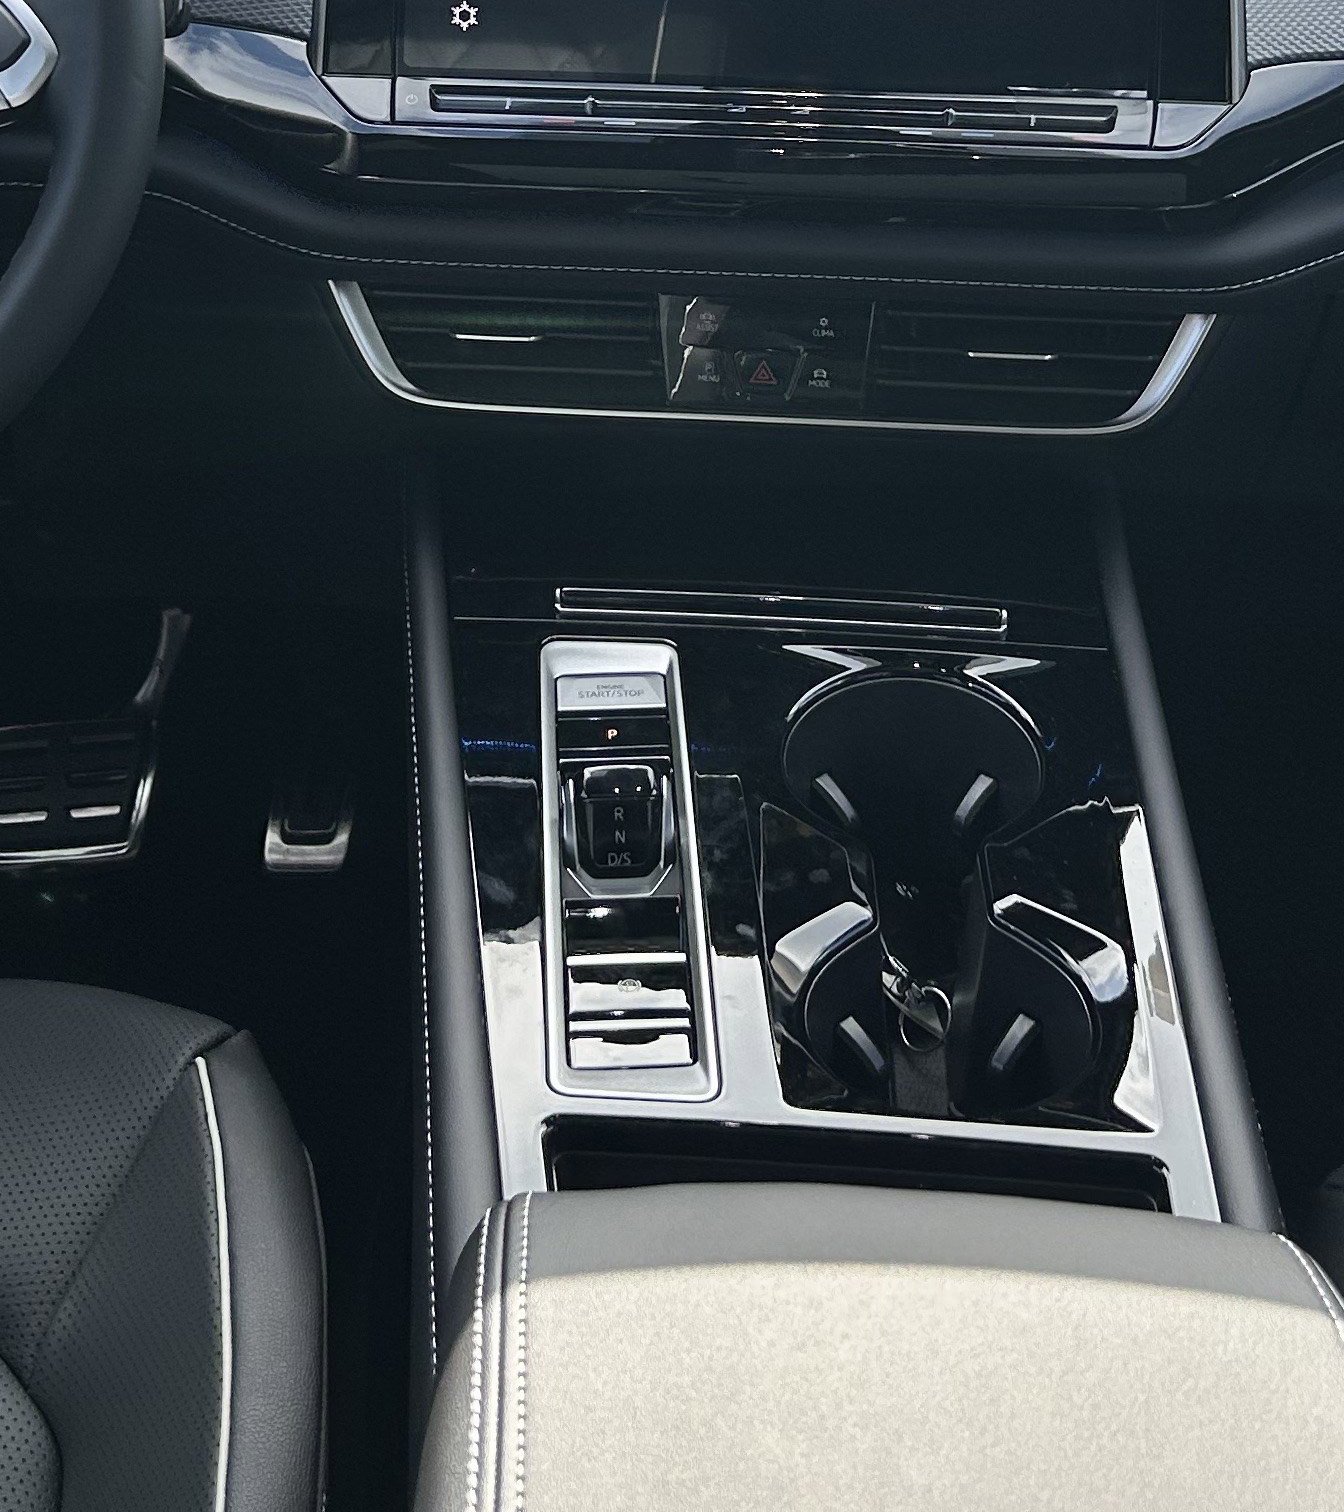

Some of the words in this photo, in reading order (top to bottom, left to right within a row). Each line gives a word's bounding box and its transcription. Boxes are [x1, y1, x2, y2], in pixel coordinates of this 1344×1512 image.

[808, 380, 831, 389] MODE
[577, 688, 644, 699] START/STOP
[607, 729, 618, 740] P
[613, 806, 625, 822] R
[614, 829, 626, 844] N
[607, 851, 632, 867] D/S
